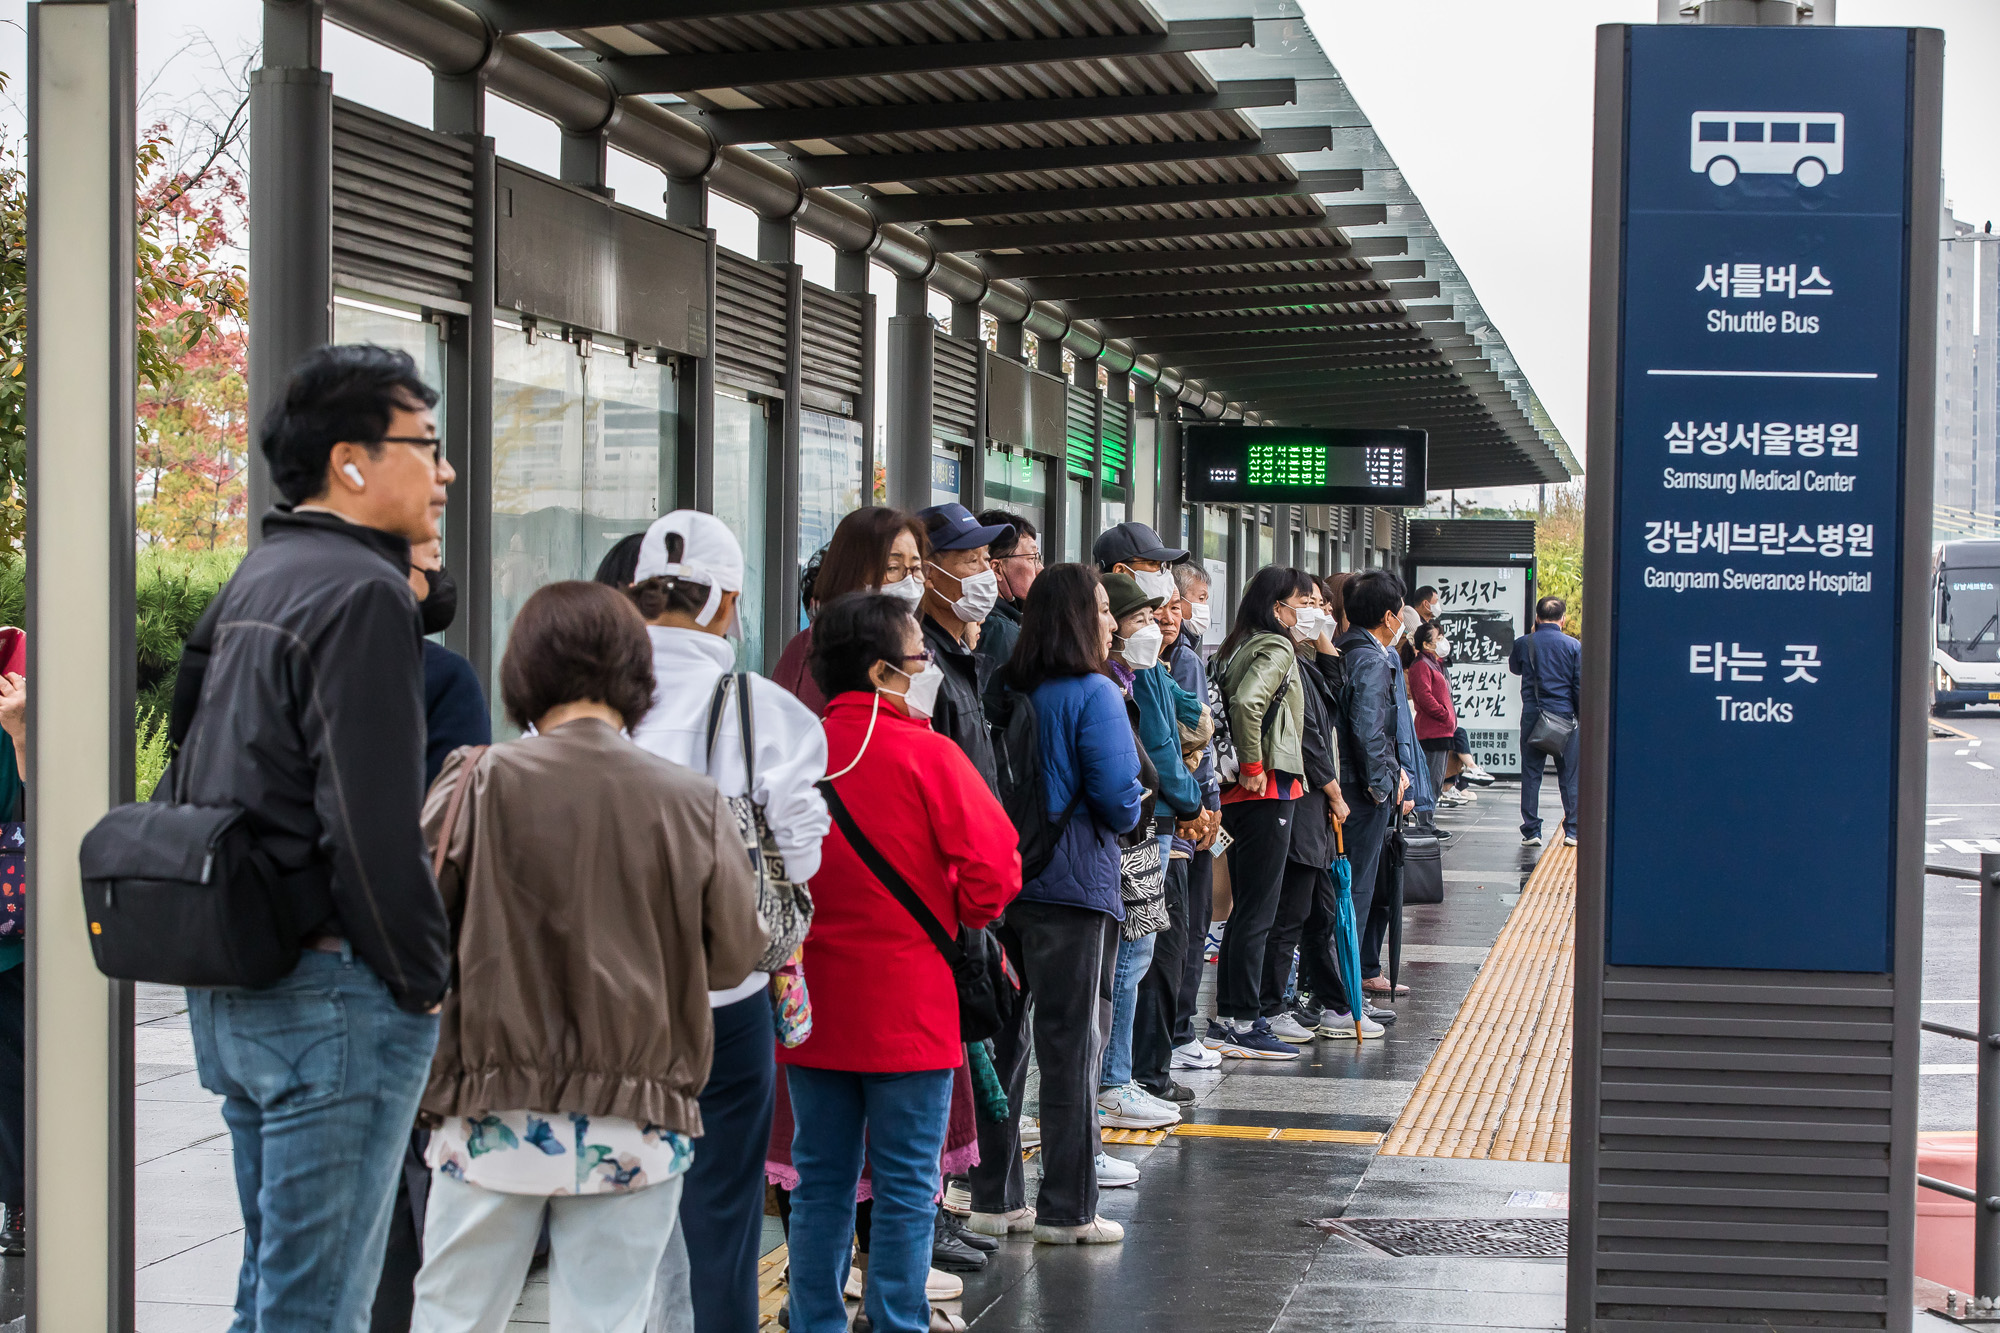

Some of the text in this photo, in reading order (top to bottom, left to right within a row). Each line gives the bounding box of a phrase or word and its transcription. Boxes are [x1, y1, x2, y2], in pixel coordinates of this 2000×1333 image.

[1695, 262, 1834, 299] 셔틀버스
[1706, 309, 1820, 334] Shuttle Bus
[1663, 420, 1859, 457] 삼성서울병원
[1663, 467, 1857, 495] Samsung Medical Center
[1644, 520, 1874, 558] 강남세브란스병원
[1438, 578, 1507, 606] 퇴직자
[1644, 566, 1872, 596] Gangnam Severance Hospital
[1440, 616, 1478, 640] 폐암
[1689, 641, 1822, 684] 타는 곳
[1715, 695, 1794, 723] Tracks
[1472, 752, 1516, 766] 1.9615
